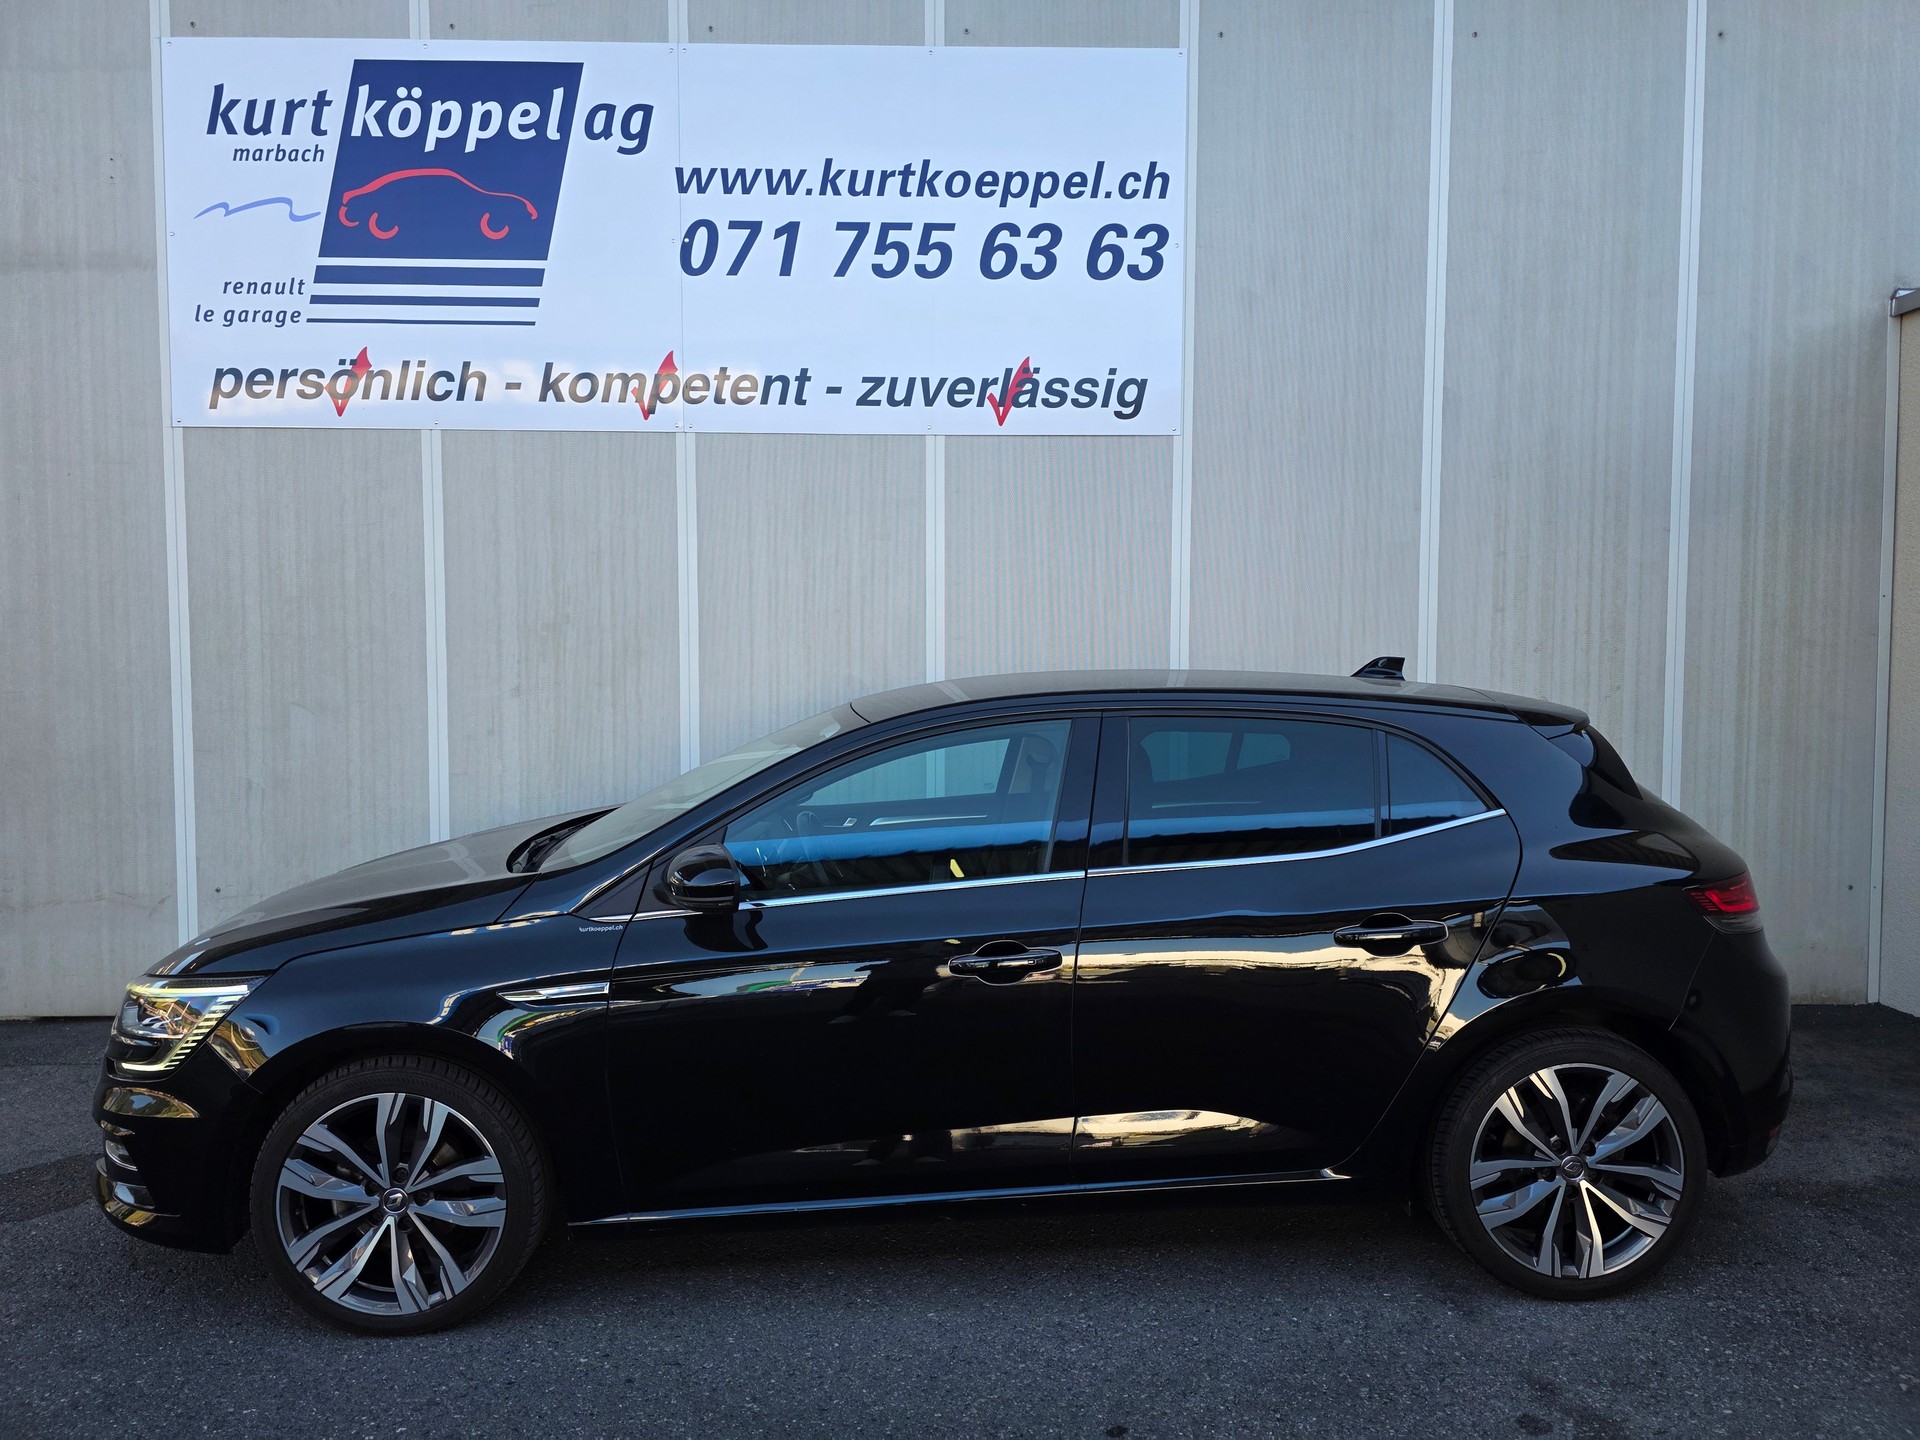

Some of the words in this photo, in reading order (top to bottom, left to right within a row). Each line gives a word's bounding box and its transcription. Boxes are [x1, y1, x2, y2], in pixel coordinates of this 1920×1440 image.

[207, 83, 333, 136] kurt
[351, 84, 563, 153] köppel
[585, 103, 654, 155] ag
[233, 144, 324, 162] marbach
[675, 158, 1170, 208] www.kurtkoeppel.ch
[680, 219, 801, 276] 071
[834, 222, 956, 279] 755
[980, 223, 1063, 281] 63
[1087, 223, 1170, 281] 63
[223, 277, 305, 295] renault
[195, 305, 214, 322] le
[223, 310, 301, 327] garage
[209, 358, 487, 409] persönlich
[539, 362, 811, 415] kompetent
[856, 366, 1148, 420] zuverlässig
